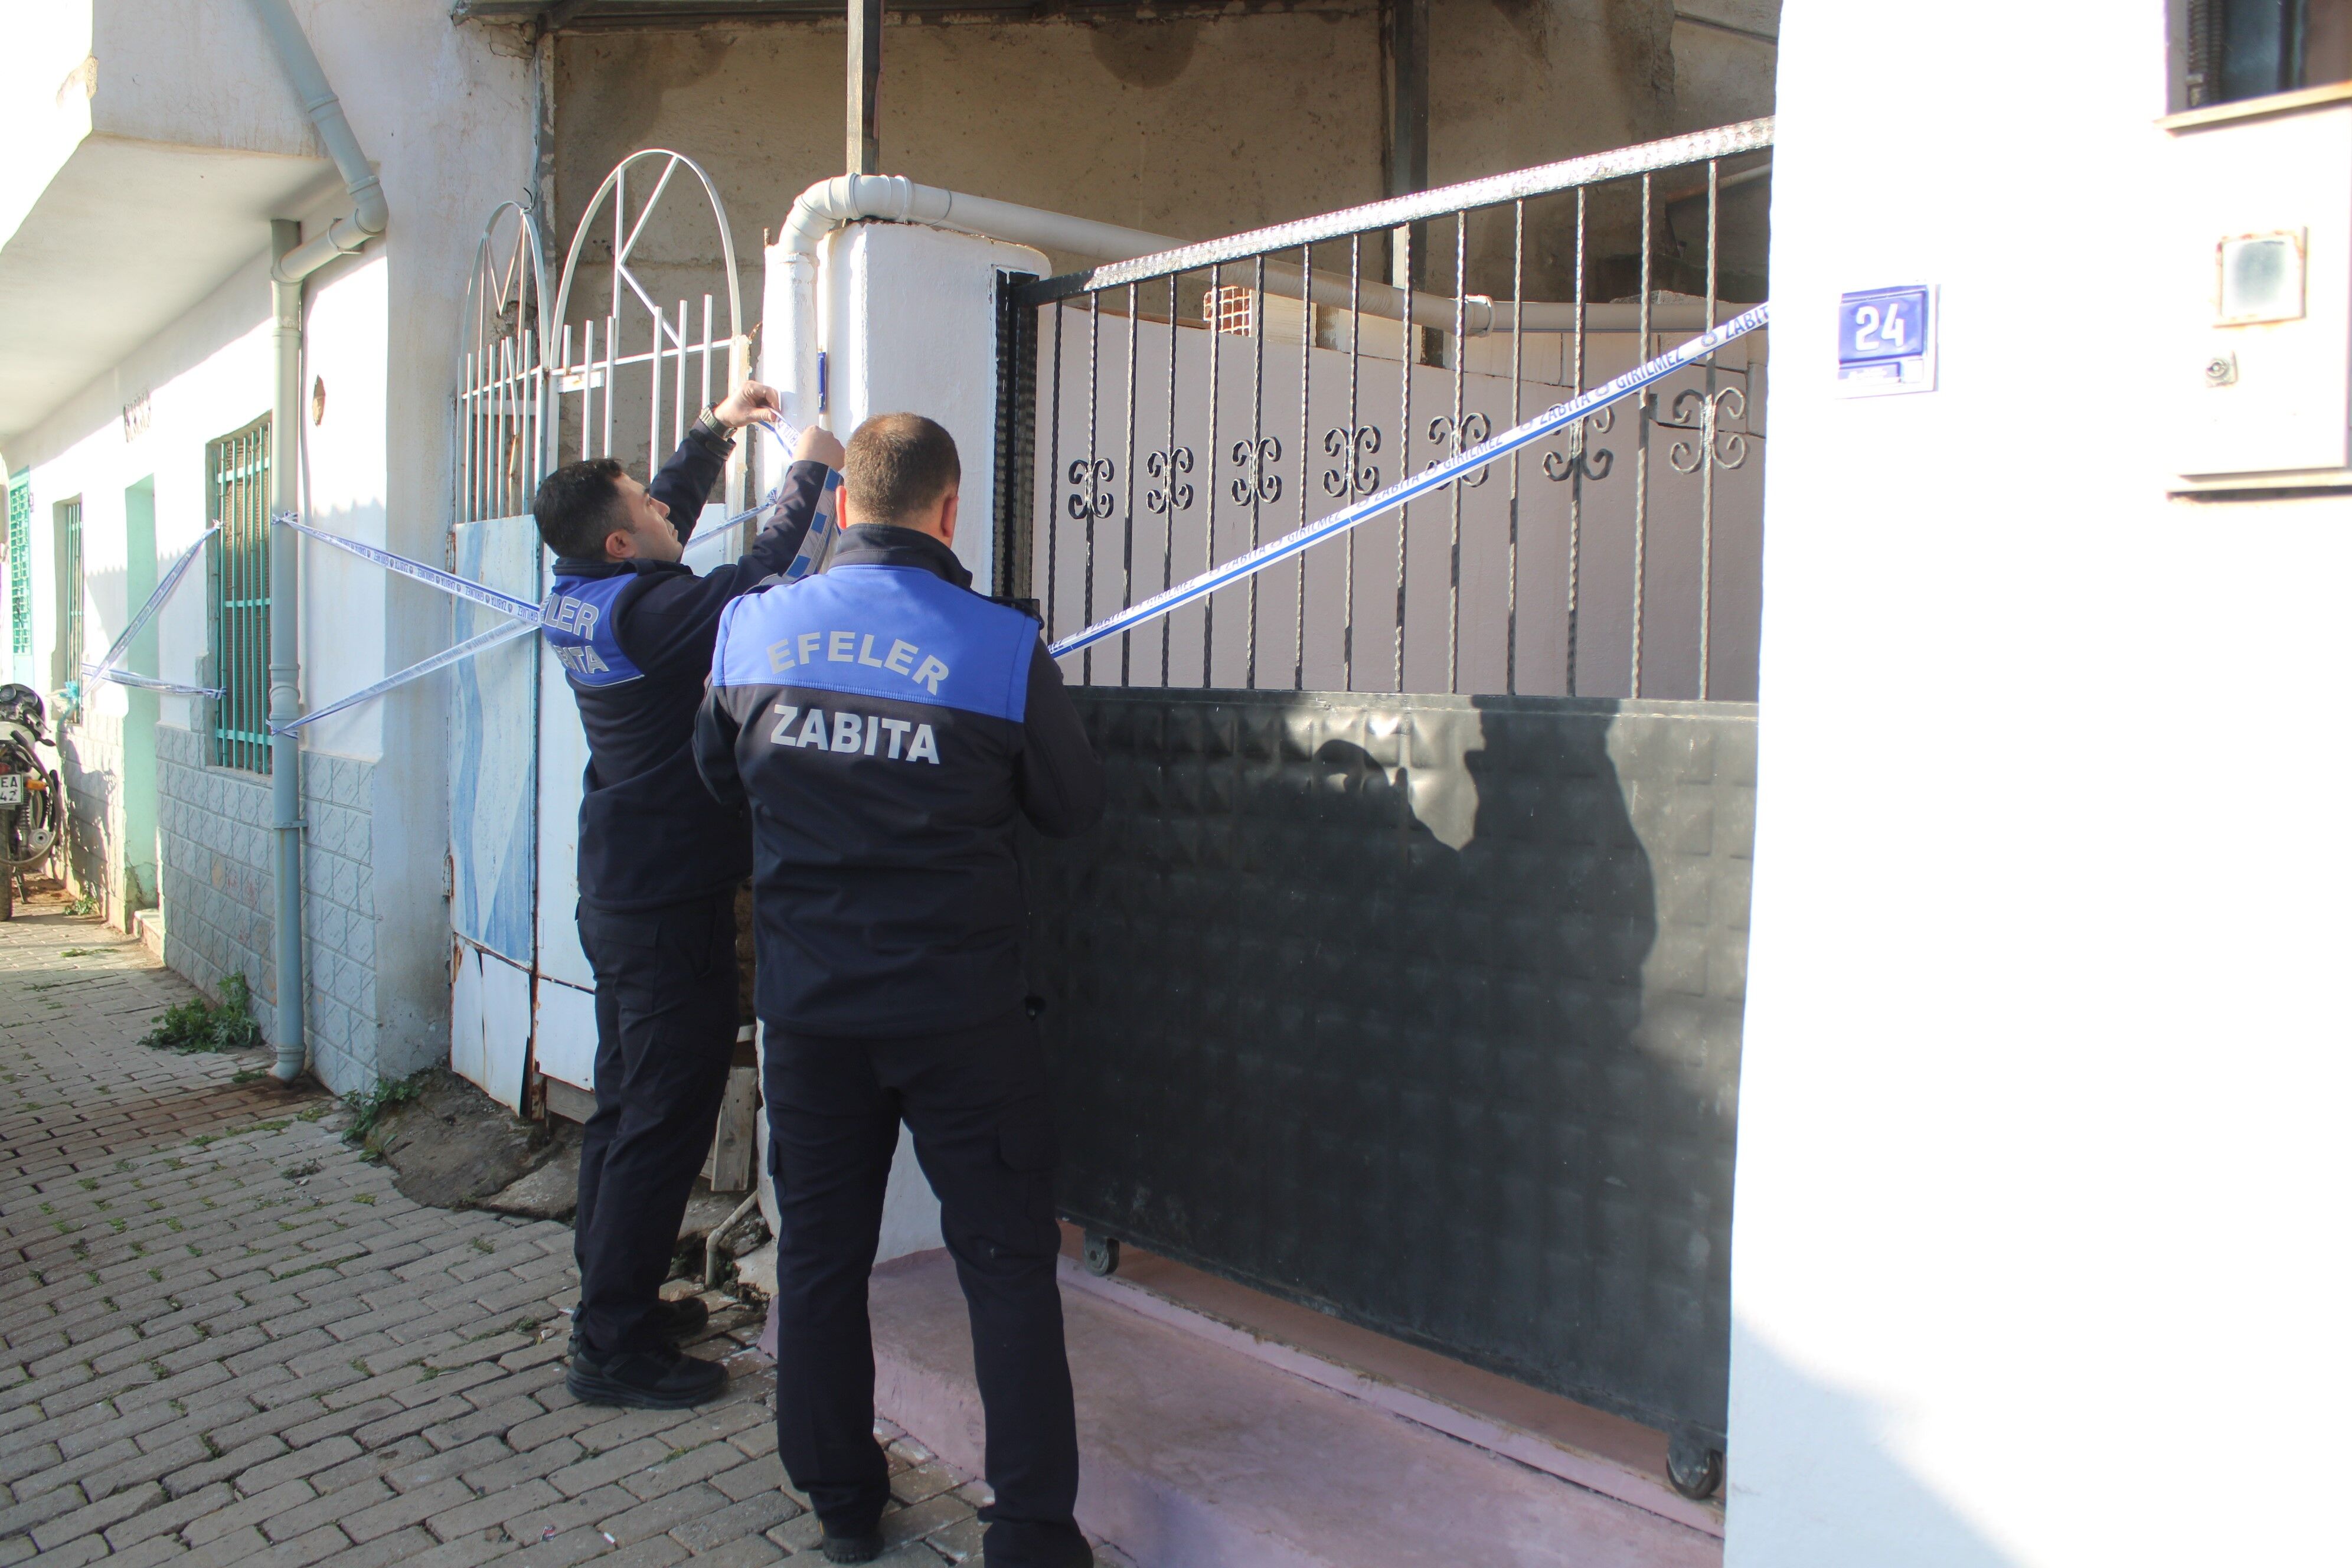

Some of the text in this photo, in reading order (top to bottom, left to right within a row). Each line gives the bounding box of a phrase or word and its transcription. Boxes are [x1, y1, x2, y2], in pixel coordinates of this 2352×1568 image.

[1725, 305, 1769, 339] ZABIT
[1856, 303, 1905, 352] 24
[541, 592, 599, 641] LER
[767, 631, 950, 696] EFELER
[769, 704, 940, 766] ZABITA
